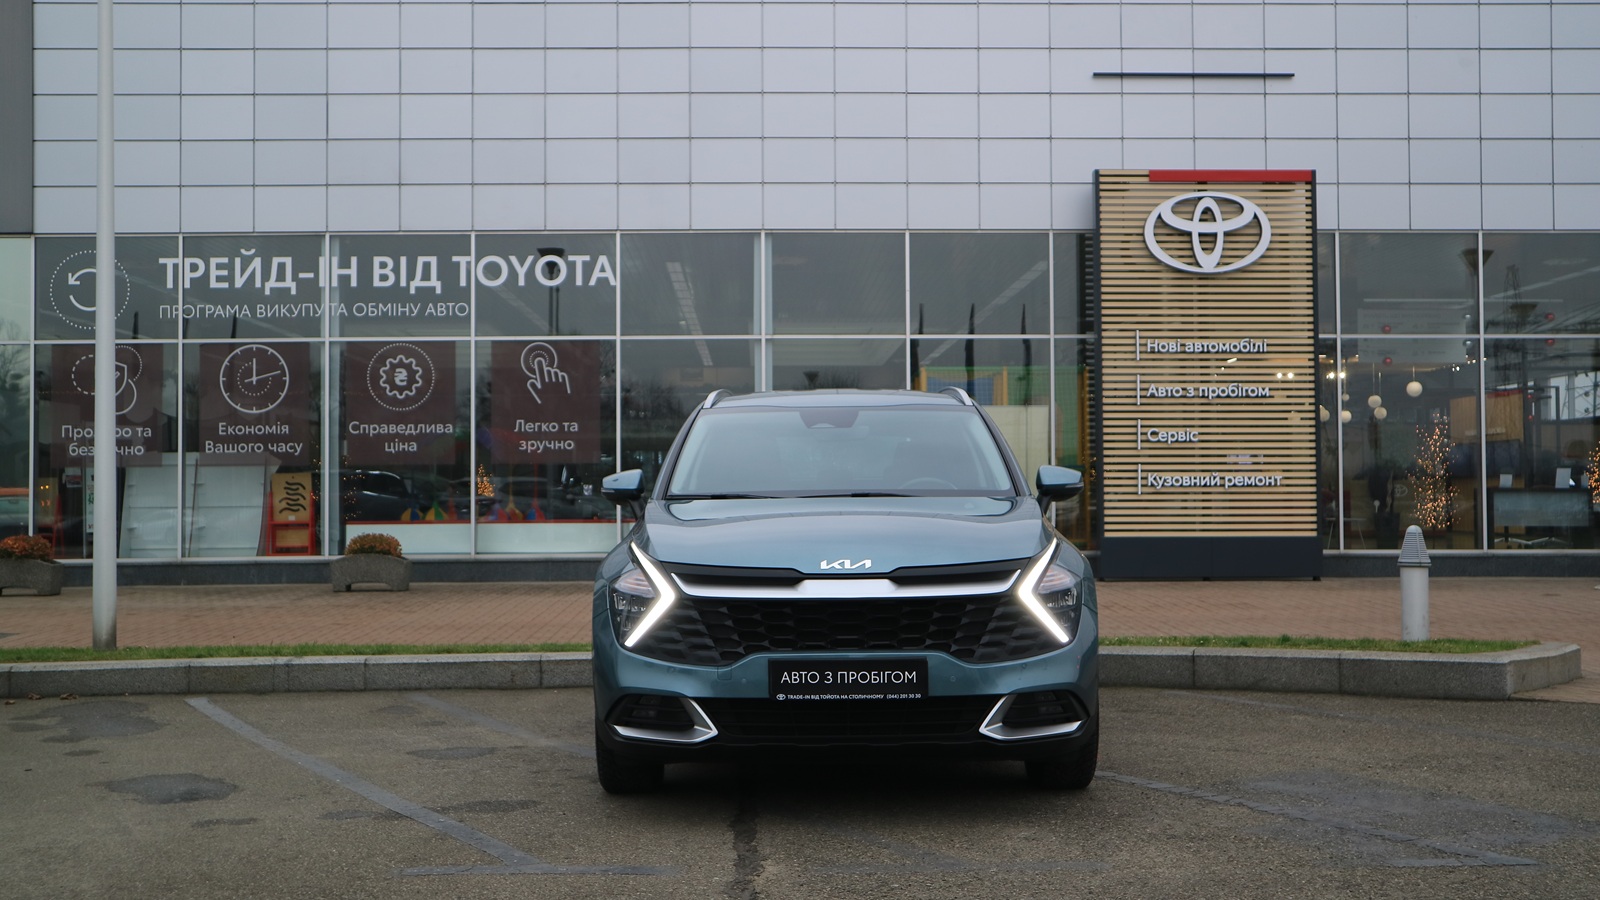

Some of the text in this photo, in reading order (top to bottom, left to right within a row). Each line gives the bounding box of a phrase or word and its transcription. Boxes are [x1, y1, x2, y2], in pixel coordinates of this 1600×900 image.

[158, 248, 617, 295] ТРЕЙД-ІН ВІД TOYOTA
[159, 302, 469, 319] ПРОГРАМА ВИКУПУ ТА ОБМІНУ АВТО
[1146, 337, 1268, 353] Нові автомобілі
[1146, 383, 1270, 399] Авто з пробігом
[136, 427, 152, 437] та
[218, 421, 289, 436] Економія
[348, 420, 453, 437] Справедлива
[513, 419, 579, 432] Легко та
[1147, 428, 1199, 444] Сервіс
[68, 442, 144, 456] безчно
[205, 440, 303, 456] Вашого часу
[384, 438, 418, 454] ціна
[518, 439, 575, 454] зручно
[1147, 473, 1283, 490] Кузовний ремонт
[780, 671, 820, 684] АВТО
[837, 671, 917, 684] ПРОБІГОМ
